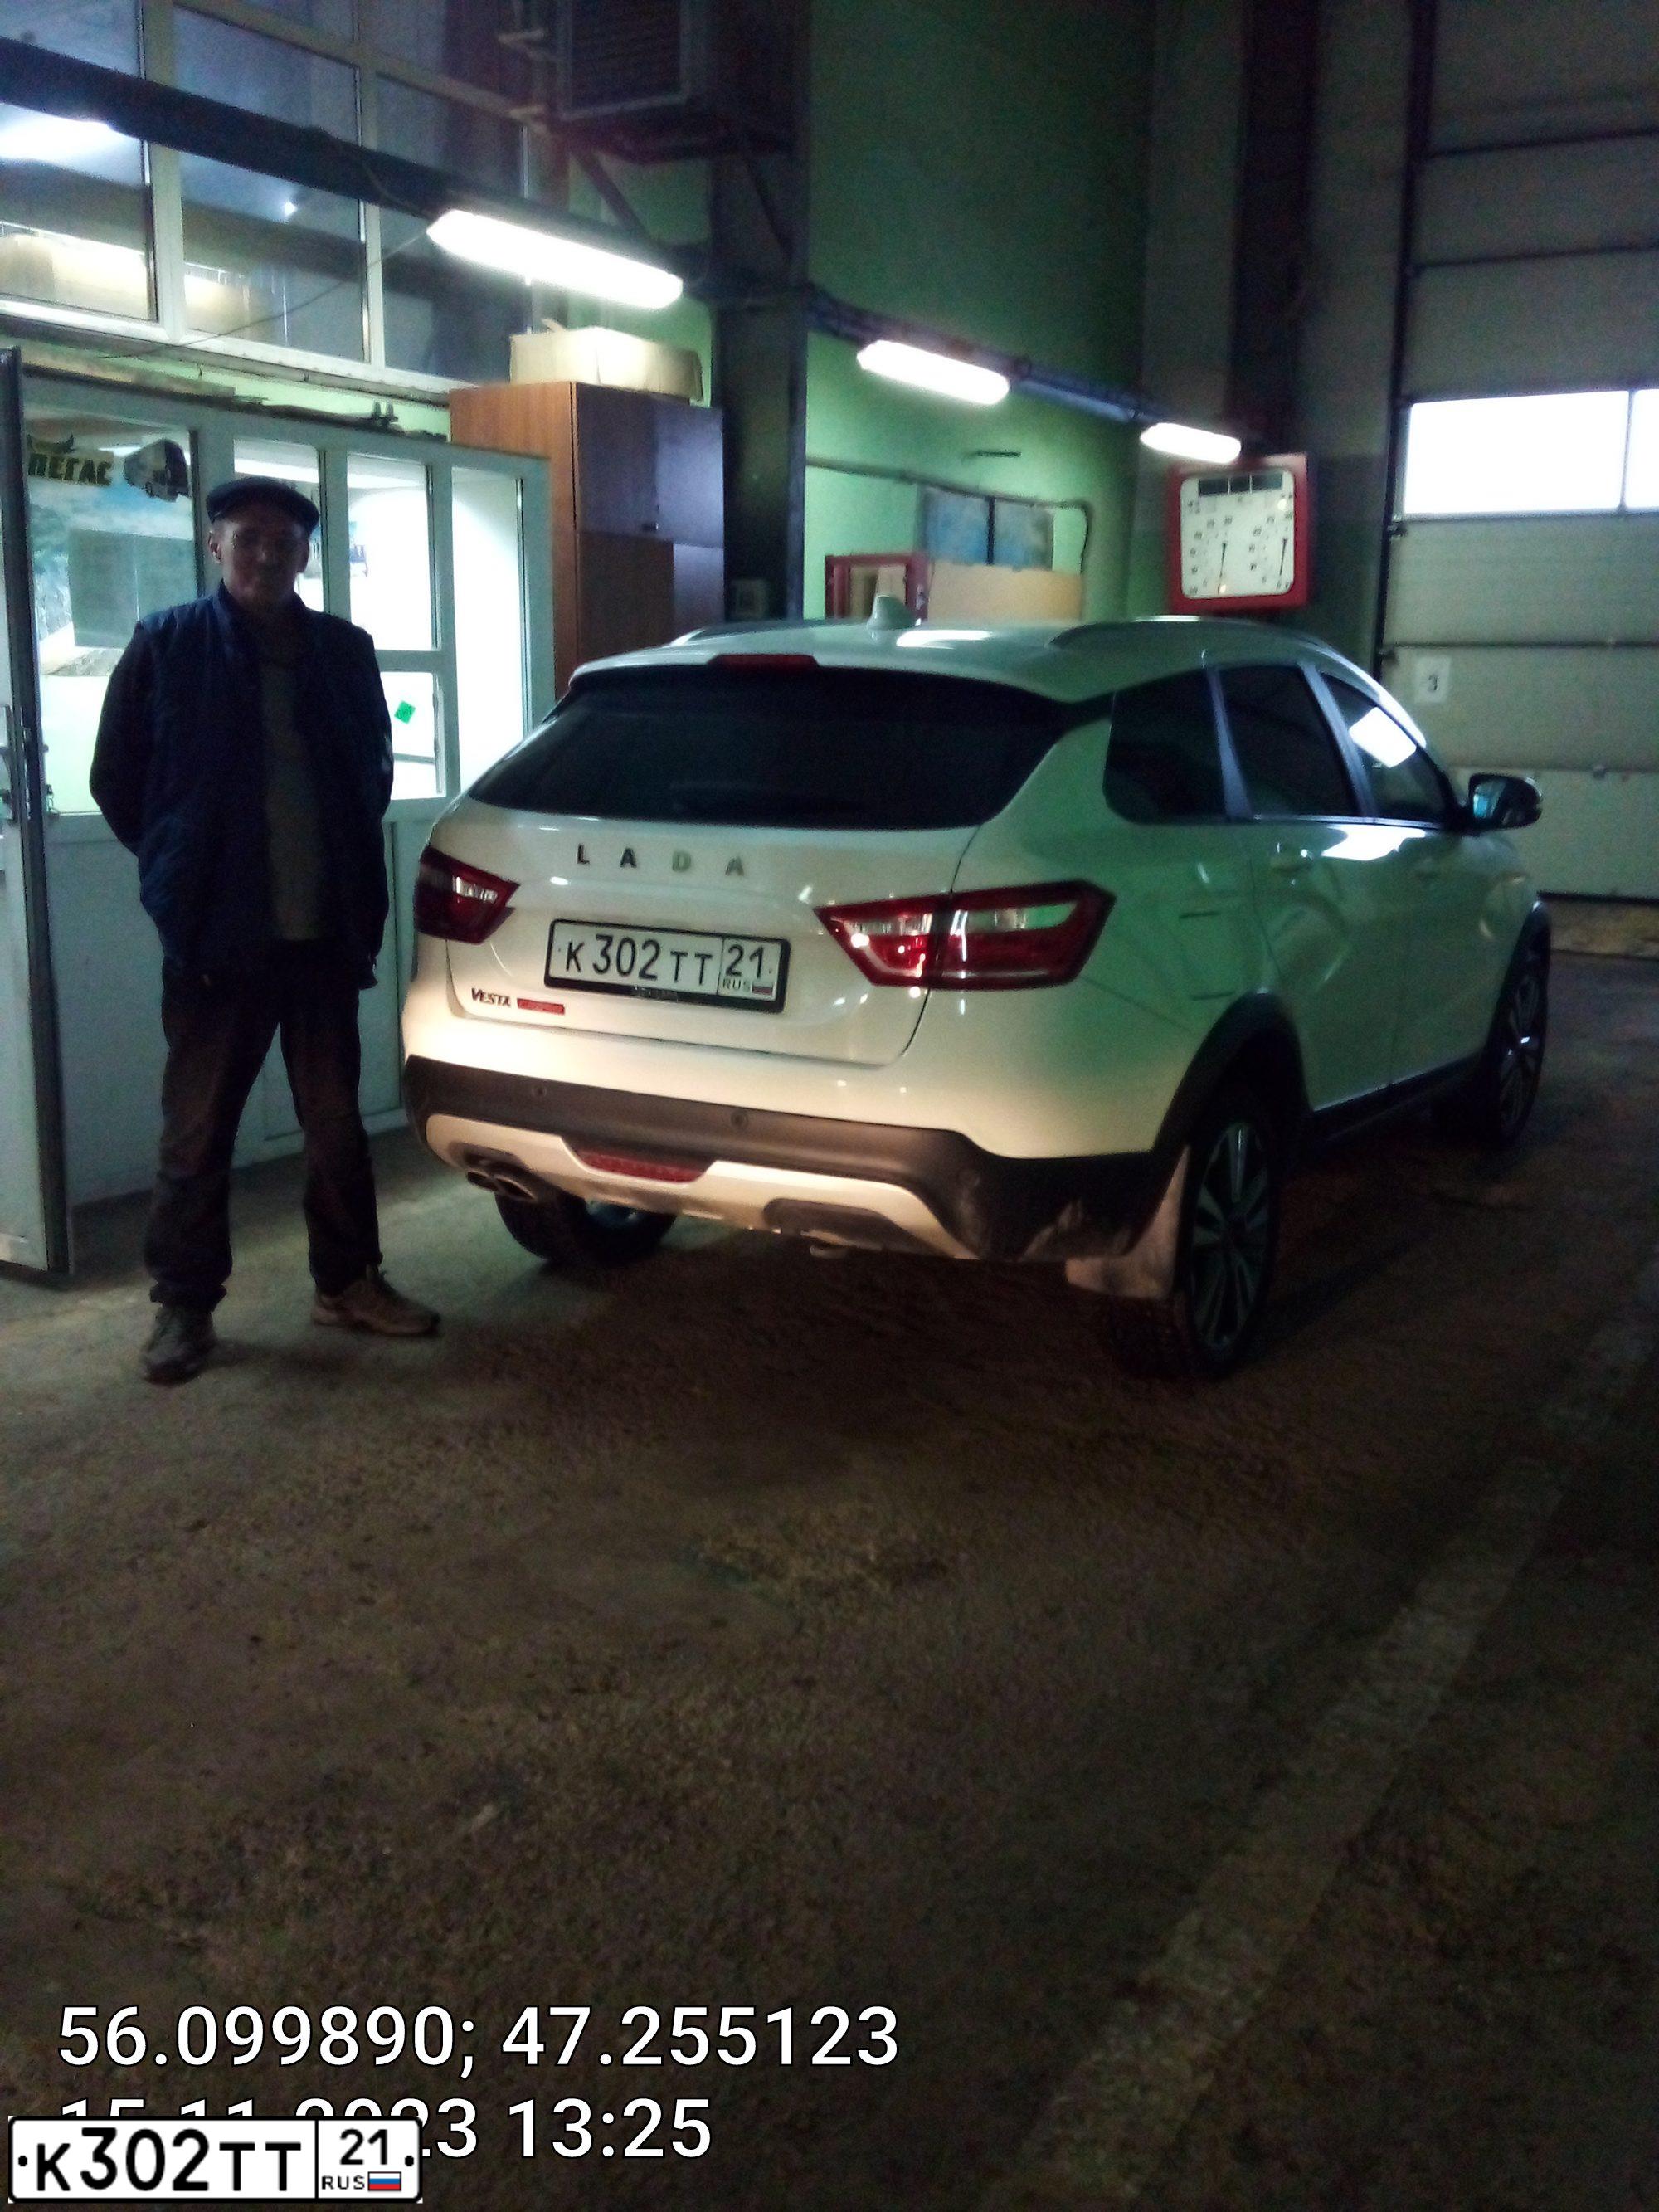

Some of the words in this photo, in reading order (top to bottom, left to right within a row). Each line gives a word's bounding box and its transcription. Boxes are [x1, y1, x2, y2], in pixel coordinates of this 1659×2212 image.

[27, 452, 113, 487] ПЕГАС
[577, 843, 745, 876] LADA
[726, 944, 764, 979] 21
[471, 987, 511, 1007] VESTA
